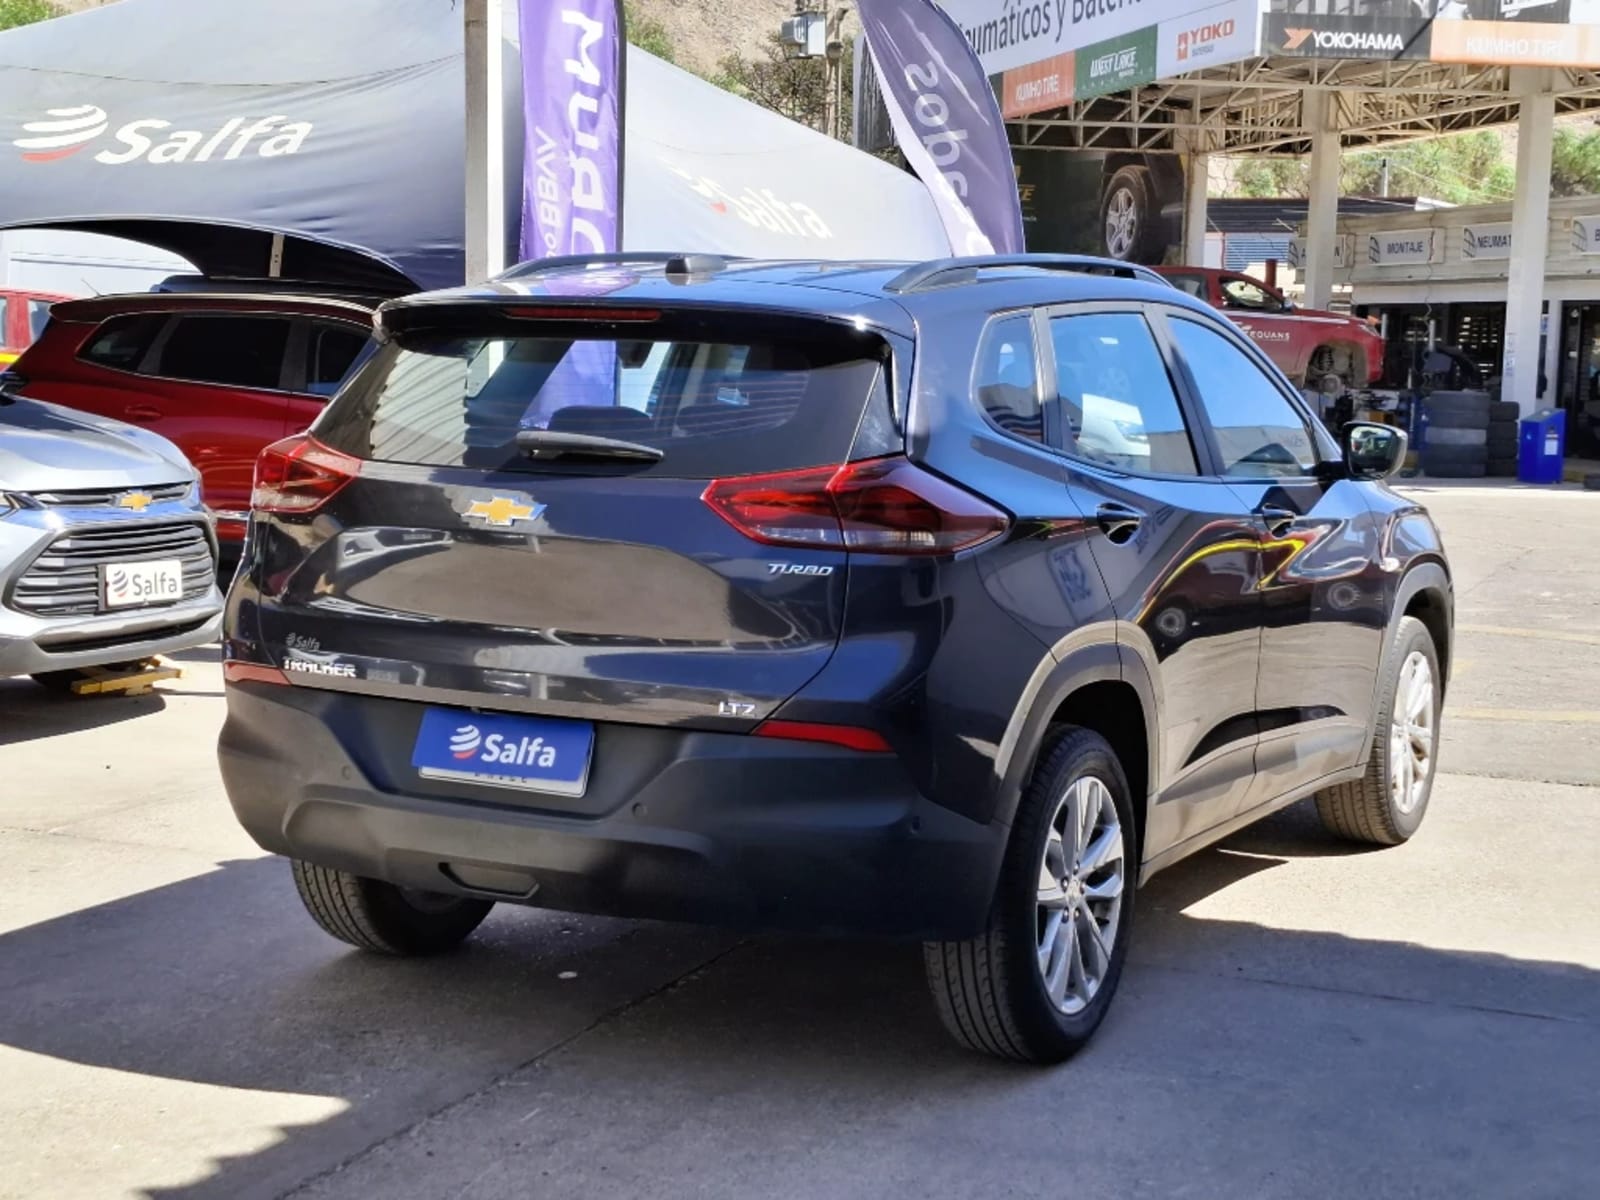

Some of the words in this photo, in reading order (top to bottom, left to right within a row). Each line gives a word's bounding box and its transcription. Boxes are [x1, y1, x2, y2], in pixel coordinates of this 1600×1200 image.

[1055, 0, 1066, 43] y
[1190, 19, 1235, 45] YOKO
[1312, 31, 1404, 51] YOKOHAMA
[1466, 37, 1529, 57] KUMHO
[94, 115, 313, 165] Salfa
[1387, 241, 1423, 255] MONTAJE
[768, 563, 834, 577] TURBO
[132, 571, 178, 597] Salfa
[295, 635, 321, 651] Salfa
[719, 702, 756, 718] LTZ
[481, 733, 557, 768] Salfa
